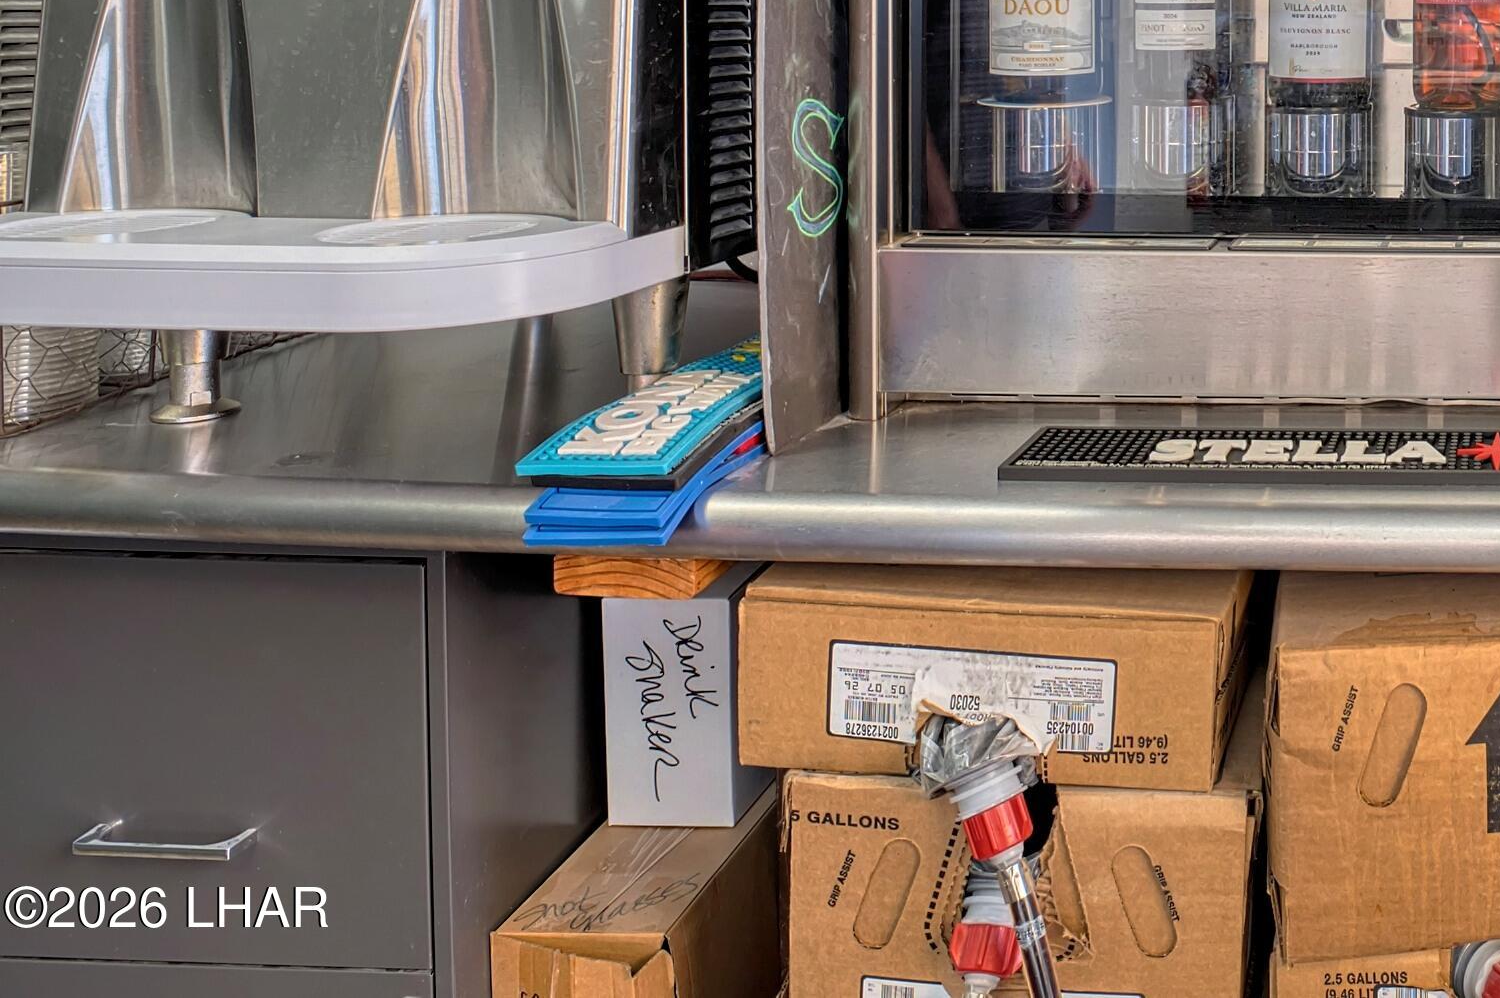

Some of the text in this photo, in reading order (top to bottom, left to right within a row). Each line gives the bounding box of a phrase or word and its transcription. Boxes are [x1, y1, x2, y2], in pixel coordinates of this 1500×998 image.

[1283, 2, 1347, 12] VILLA MARIA
[557, 369, 722, 457] KONA
[619, 414, 693, 455] BIG
[1148, 439, 1447, 464] STELLA
[844, 680, 905, 695] 05 07 26
[949, 693, 981, 712] 52030
[1046, 721, 1094, 735] 00104235
[1332, 685, 1360, 753] GRIP ASSIST
[845, 721, 899, 739] 0021236278
[1115, 734, 1168, 749] (9.46 LIT
[1082, 751, 1168, 764] 2.5 GALLONS
[806, 810, 900, 831] GALLONS
[827, 849, 857, 908] GRIP ASSIST
[1153, 864, 1181, 923] GRIP ASSIST
[1324, 971, 1408, 985] 2.5 GALLONS
